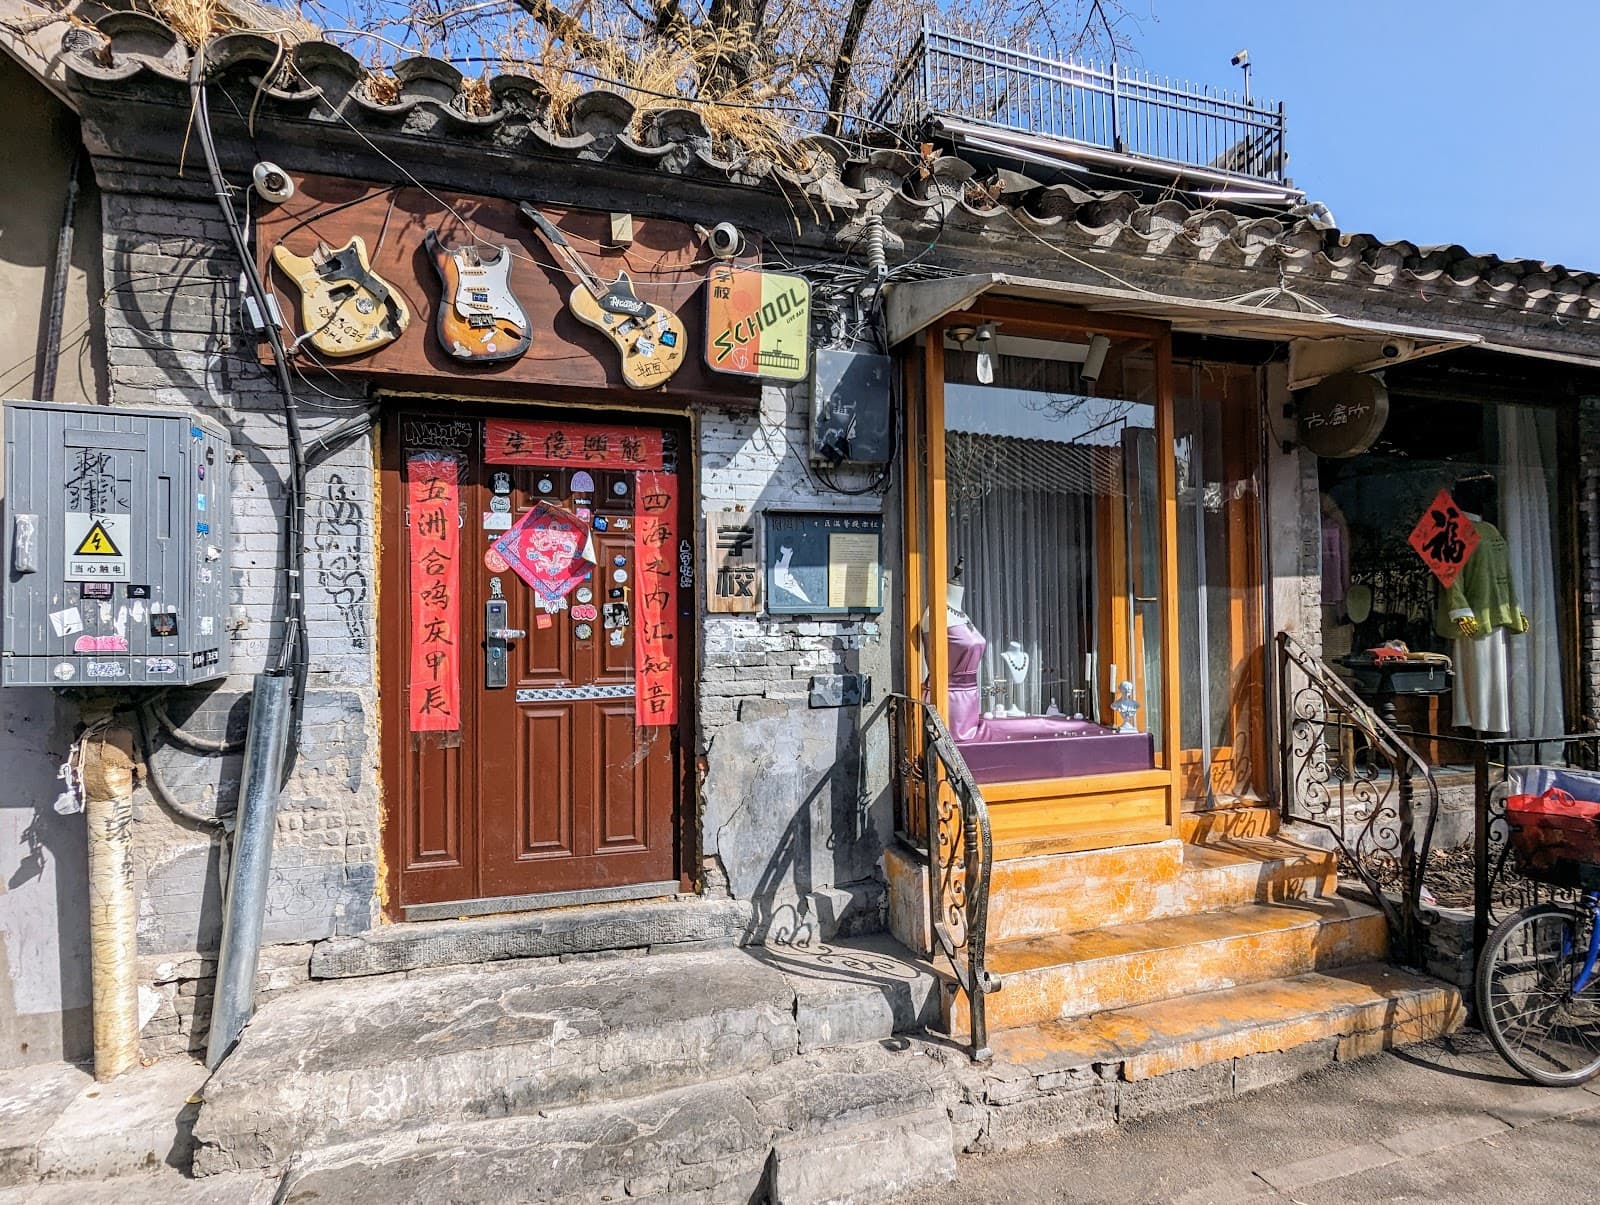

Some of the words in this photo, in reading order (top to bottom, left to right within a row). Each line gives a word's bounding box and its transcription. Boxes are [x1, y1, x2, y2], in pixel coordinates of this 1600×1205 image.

[714, 288, 806, 361] SCHOOL
[716, 525, 756, 597] 学校
[1422, 507, 1466, 564] 福
[75, 564, 121, 574] 当心触电
